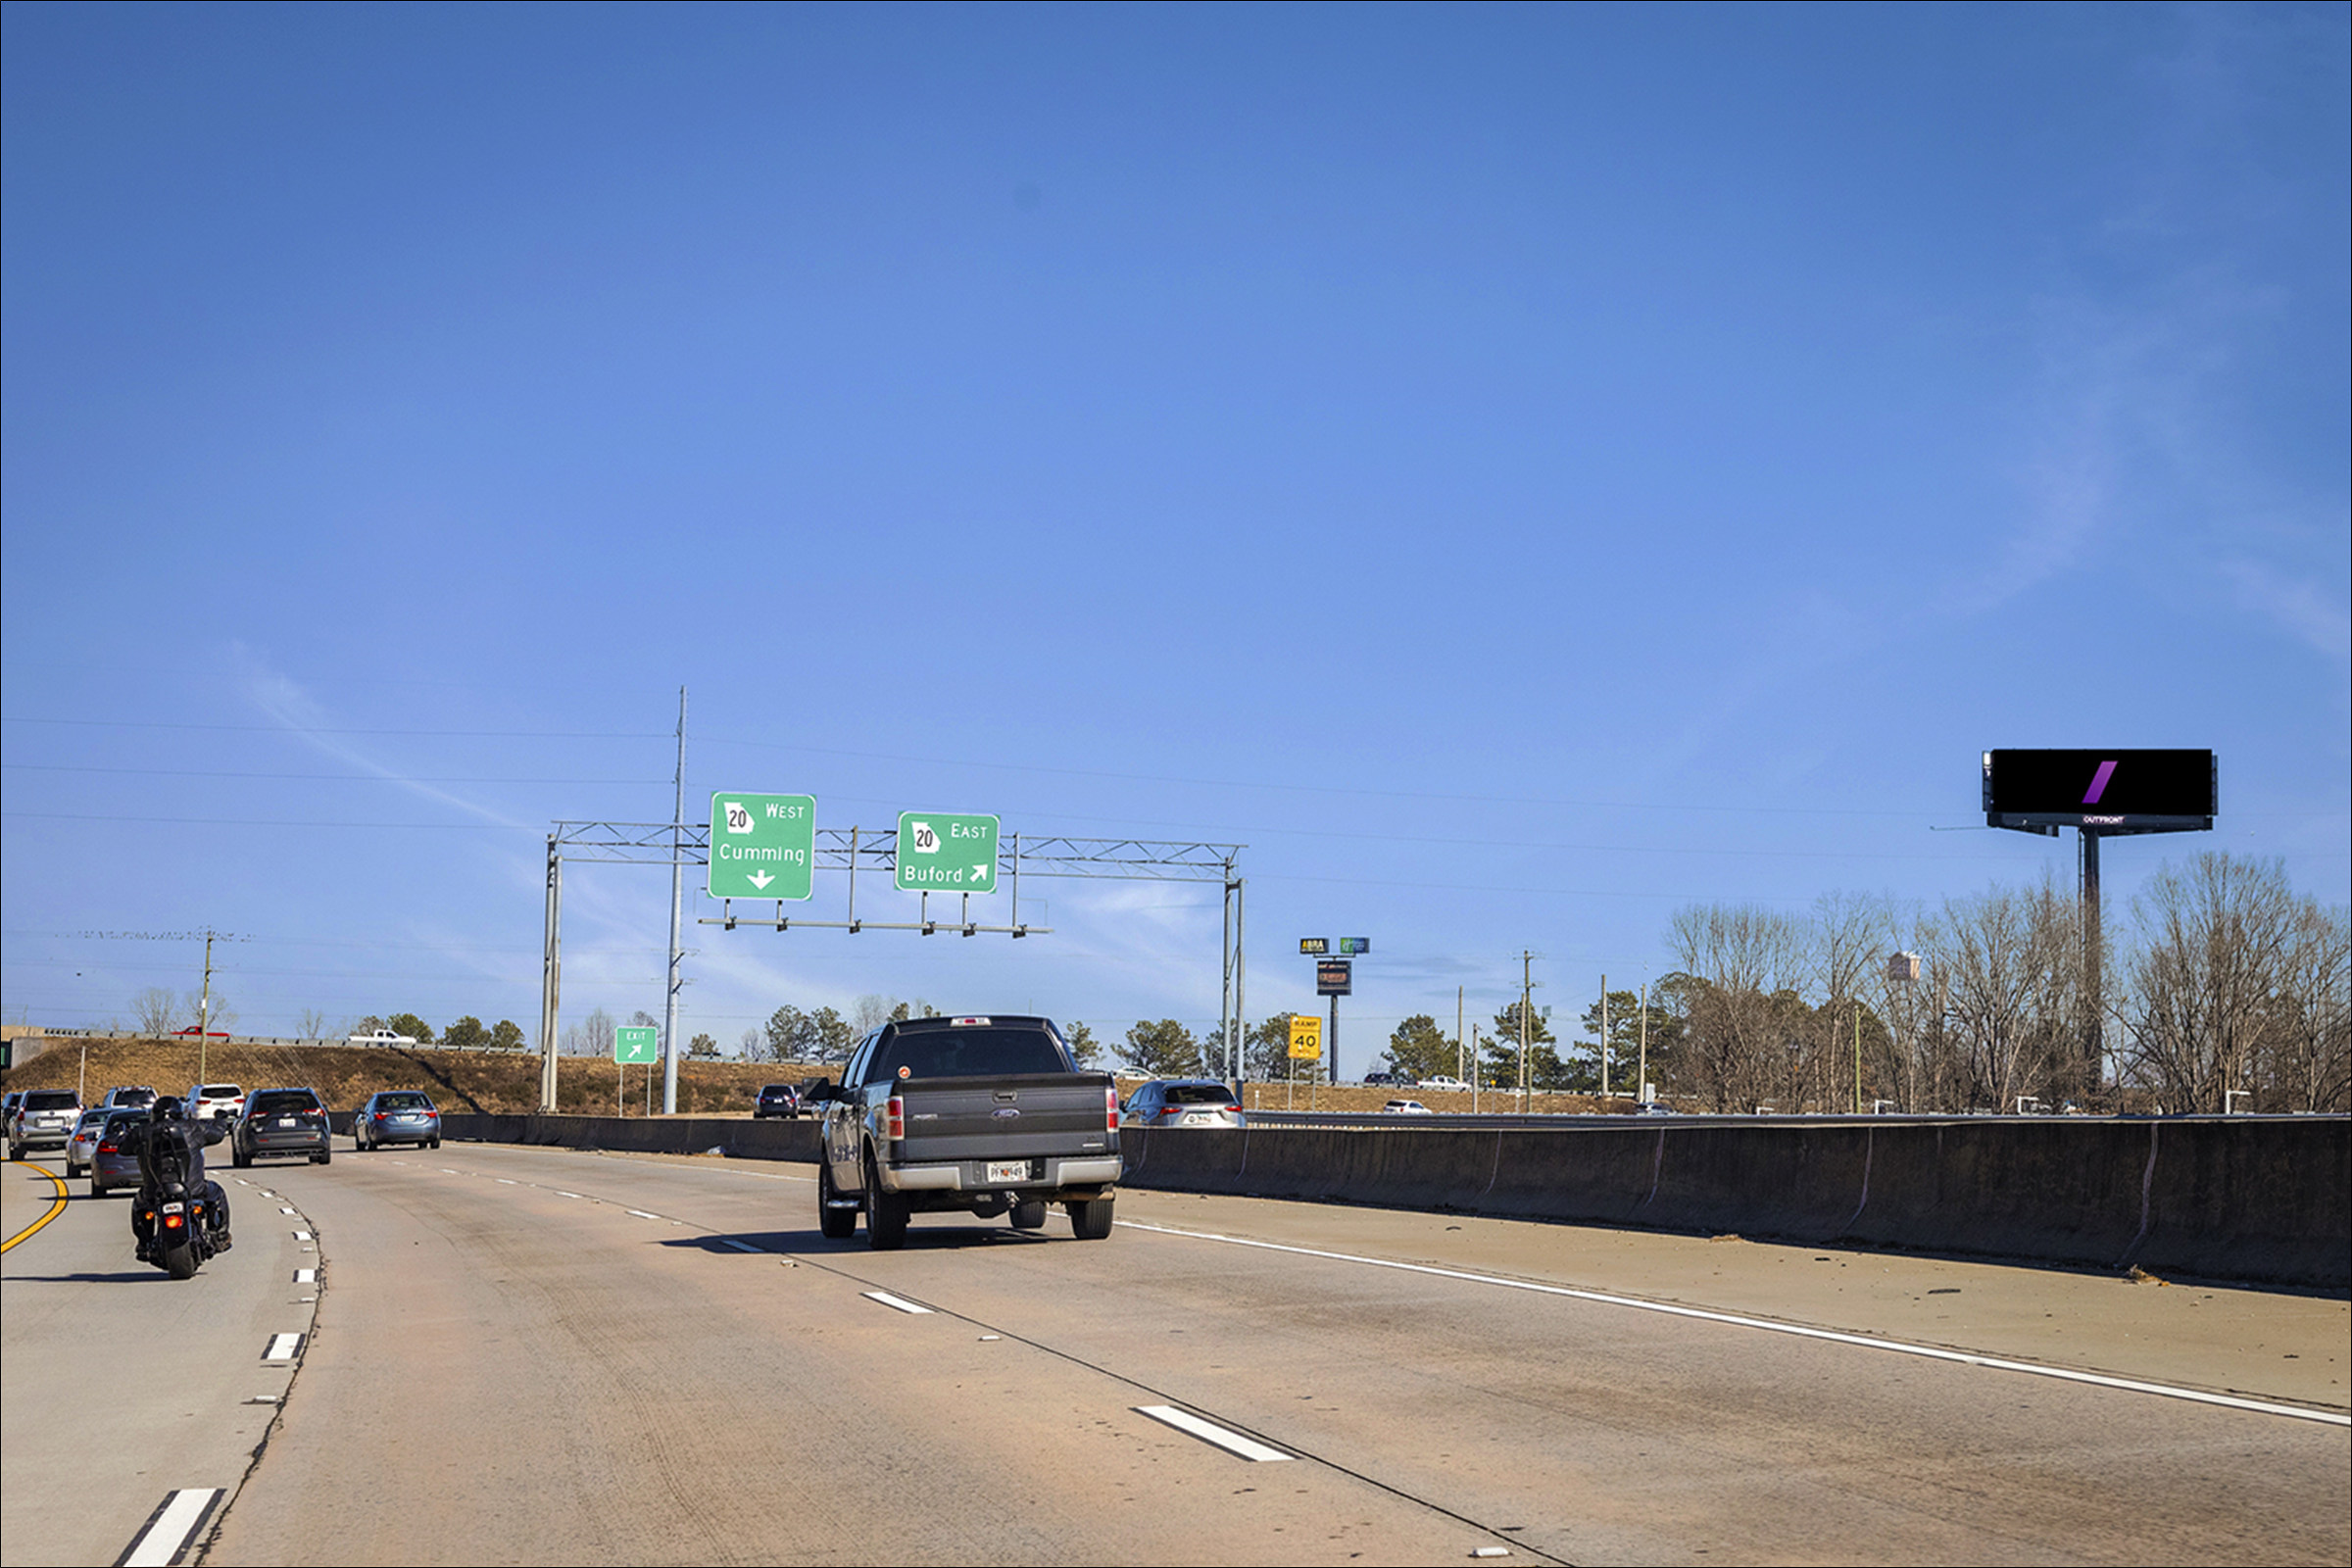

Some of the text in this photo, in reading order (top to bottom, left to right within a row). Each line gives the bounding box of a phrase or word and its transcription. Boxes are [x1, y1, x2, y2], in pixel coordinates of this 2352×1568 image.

[729, 803, 805, 828] 20 WEST
[916, 823, 988, 848] 20 EAST
[719, 843, 805, 866] Cumming
[905, 865, 962, 883] Buford
[626, 1031, 646, 1041] EXIT
[1295, 1035, 1316, 1048] 40
